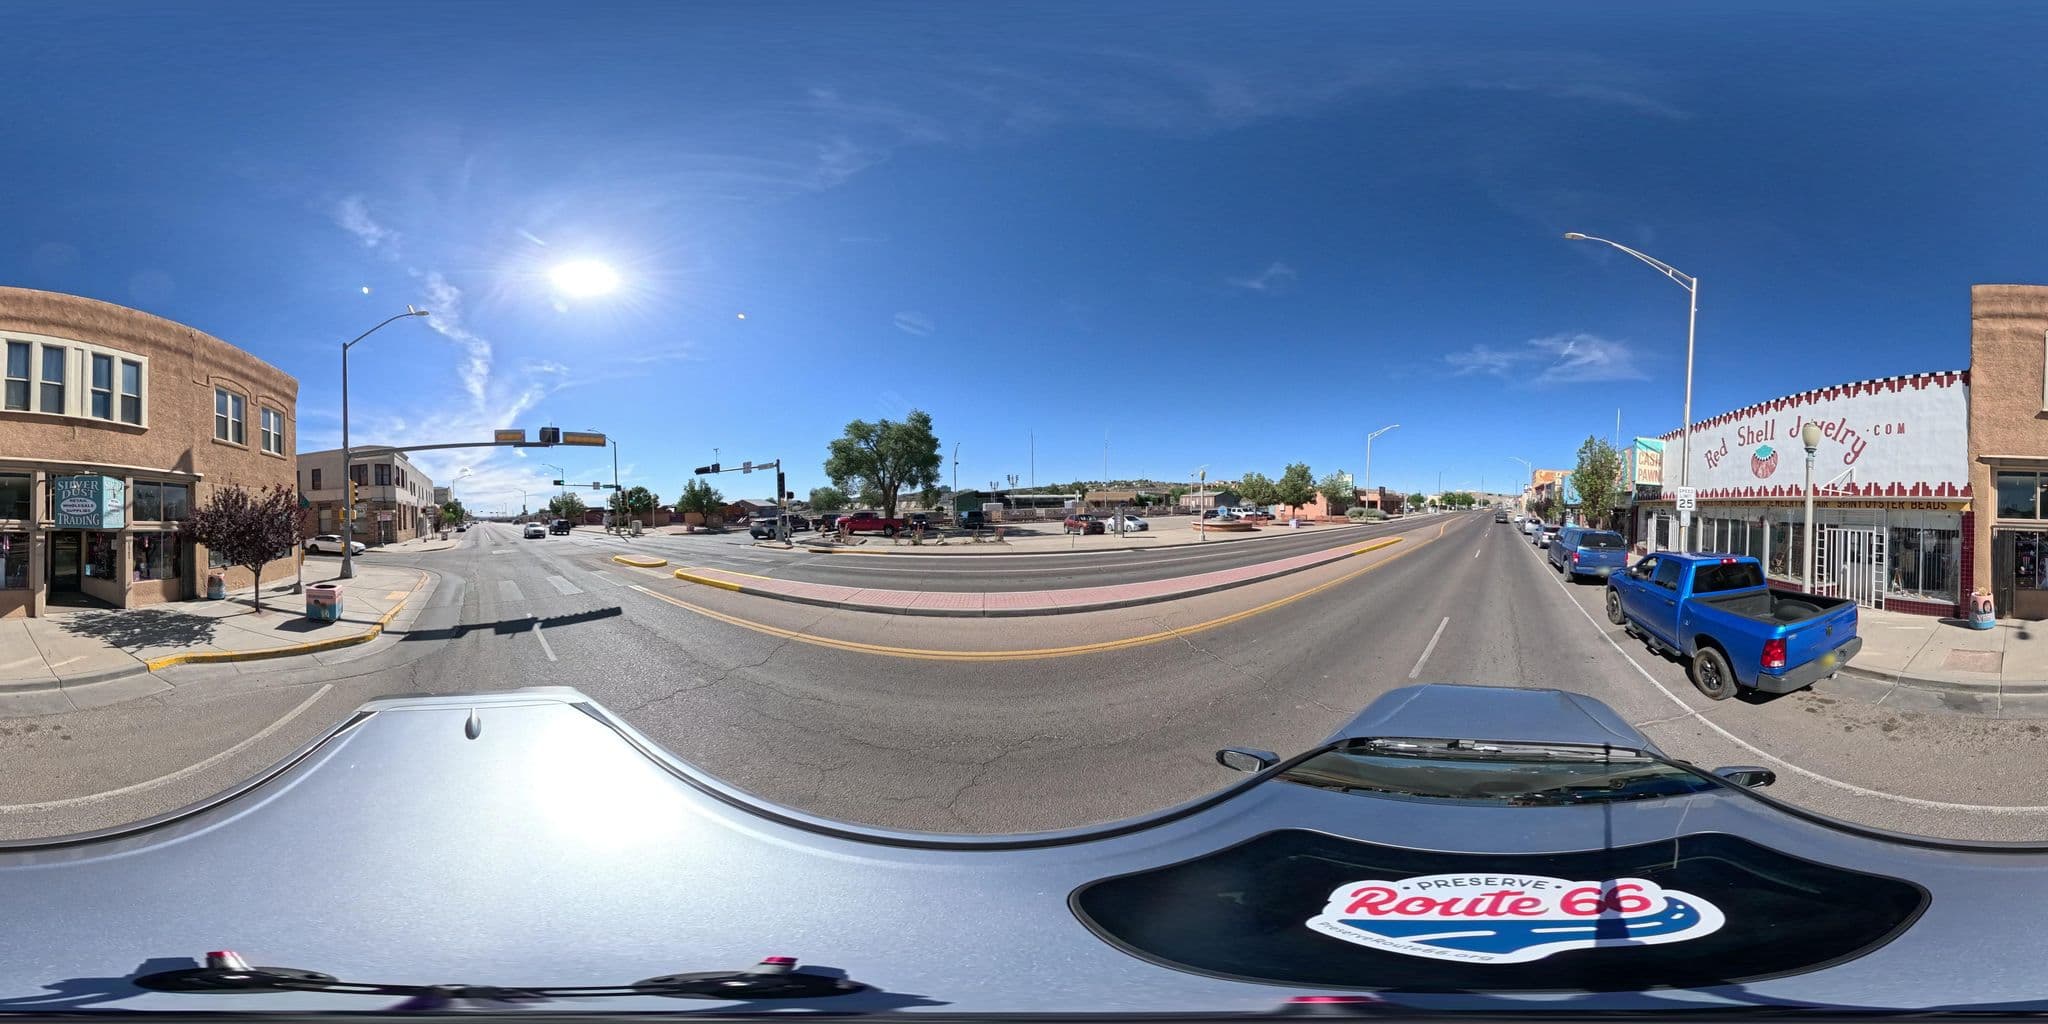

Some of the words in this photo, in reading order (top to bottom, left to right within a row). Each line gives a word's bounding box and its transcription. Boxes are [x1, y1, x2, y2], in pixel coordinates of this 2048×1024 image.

[1704, 437, 1728, 469] Red
[1737, 419, 1775, 447] Shell
[1789, 415, 1867, 465] Jwelry
[1638, 468, 1660, 483] PAWN
[57, 480, 100, 491] SILVER
[62, 488, 96, 499] DUST
[1679, 498, 1694, 509] 25
[1910, 501, 1948, 510] BEADS
[57, 513, 100, 526] TRADING
[1416, 877, 1547, 890] PRESERVE
[1345, 886, 1551, 917] Route
[1559, 883, 1652, 916] 66
